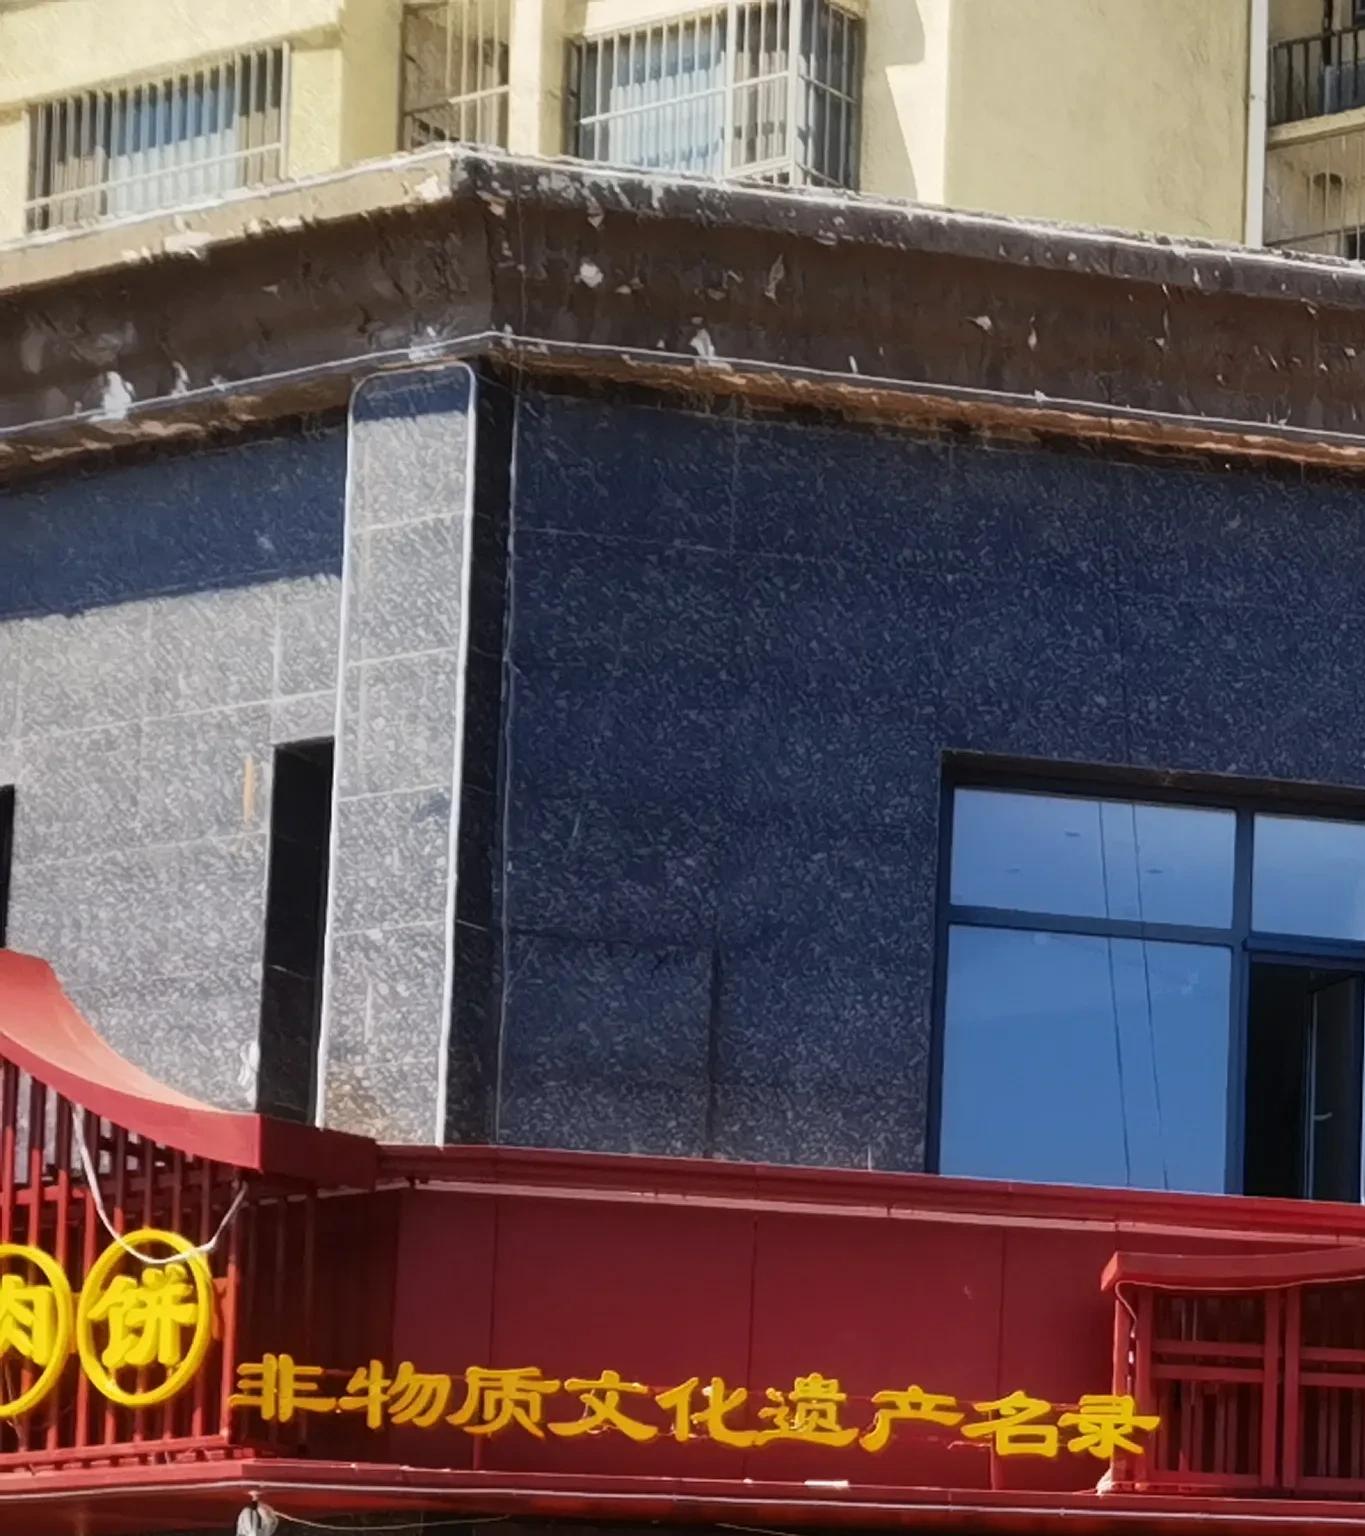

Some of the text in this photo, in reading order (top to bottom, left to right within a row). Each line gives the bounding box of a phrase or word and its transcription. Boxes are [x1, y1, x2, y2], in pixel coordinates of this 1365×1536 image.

[228, 1353, 1161, 1460] 非物质文化遗产名录
